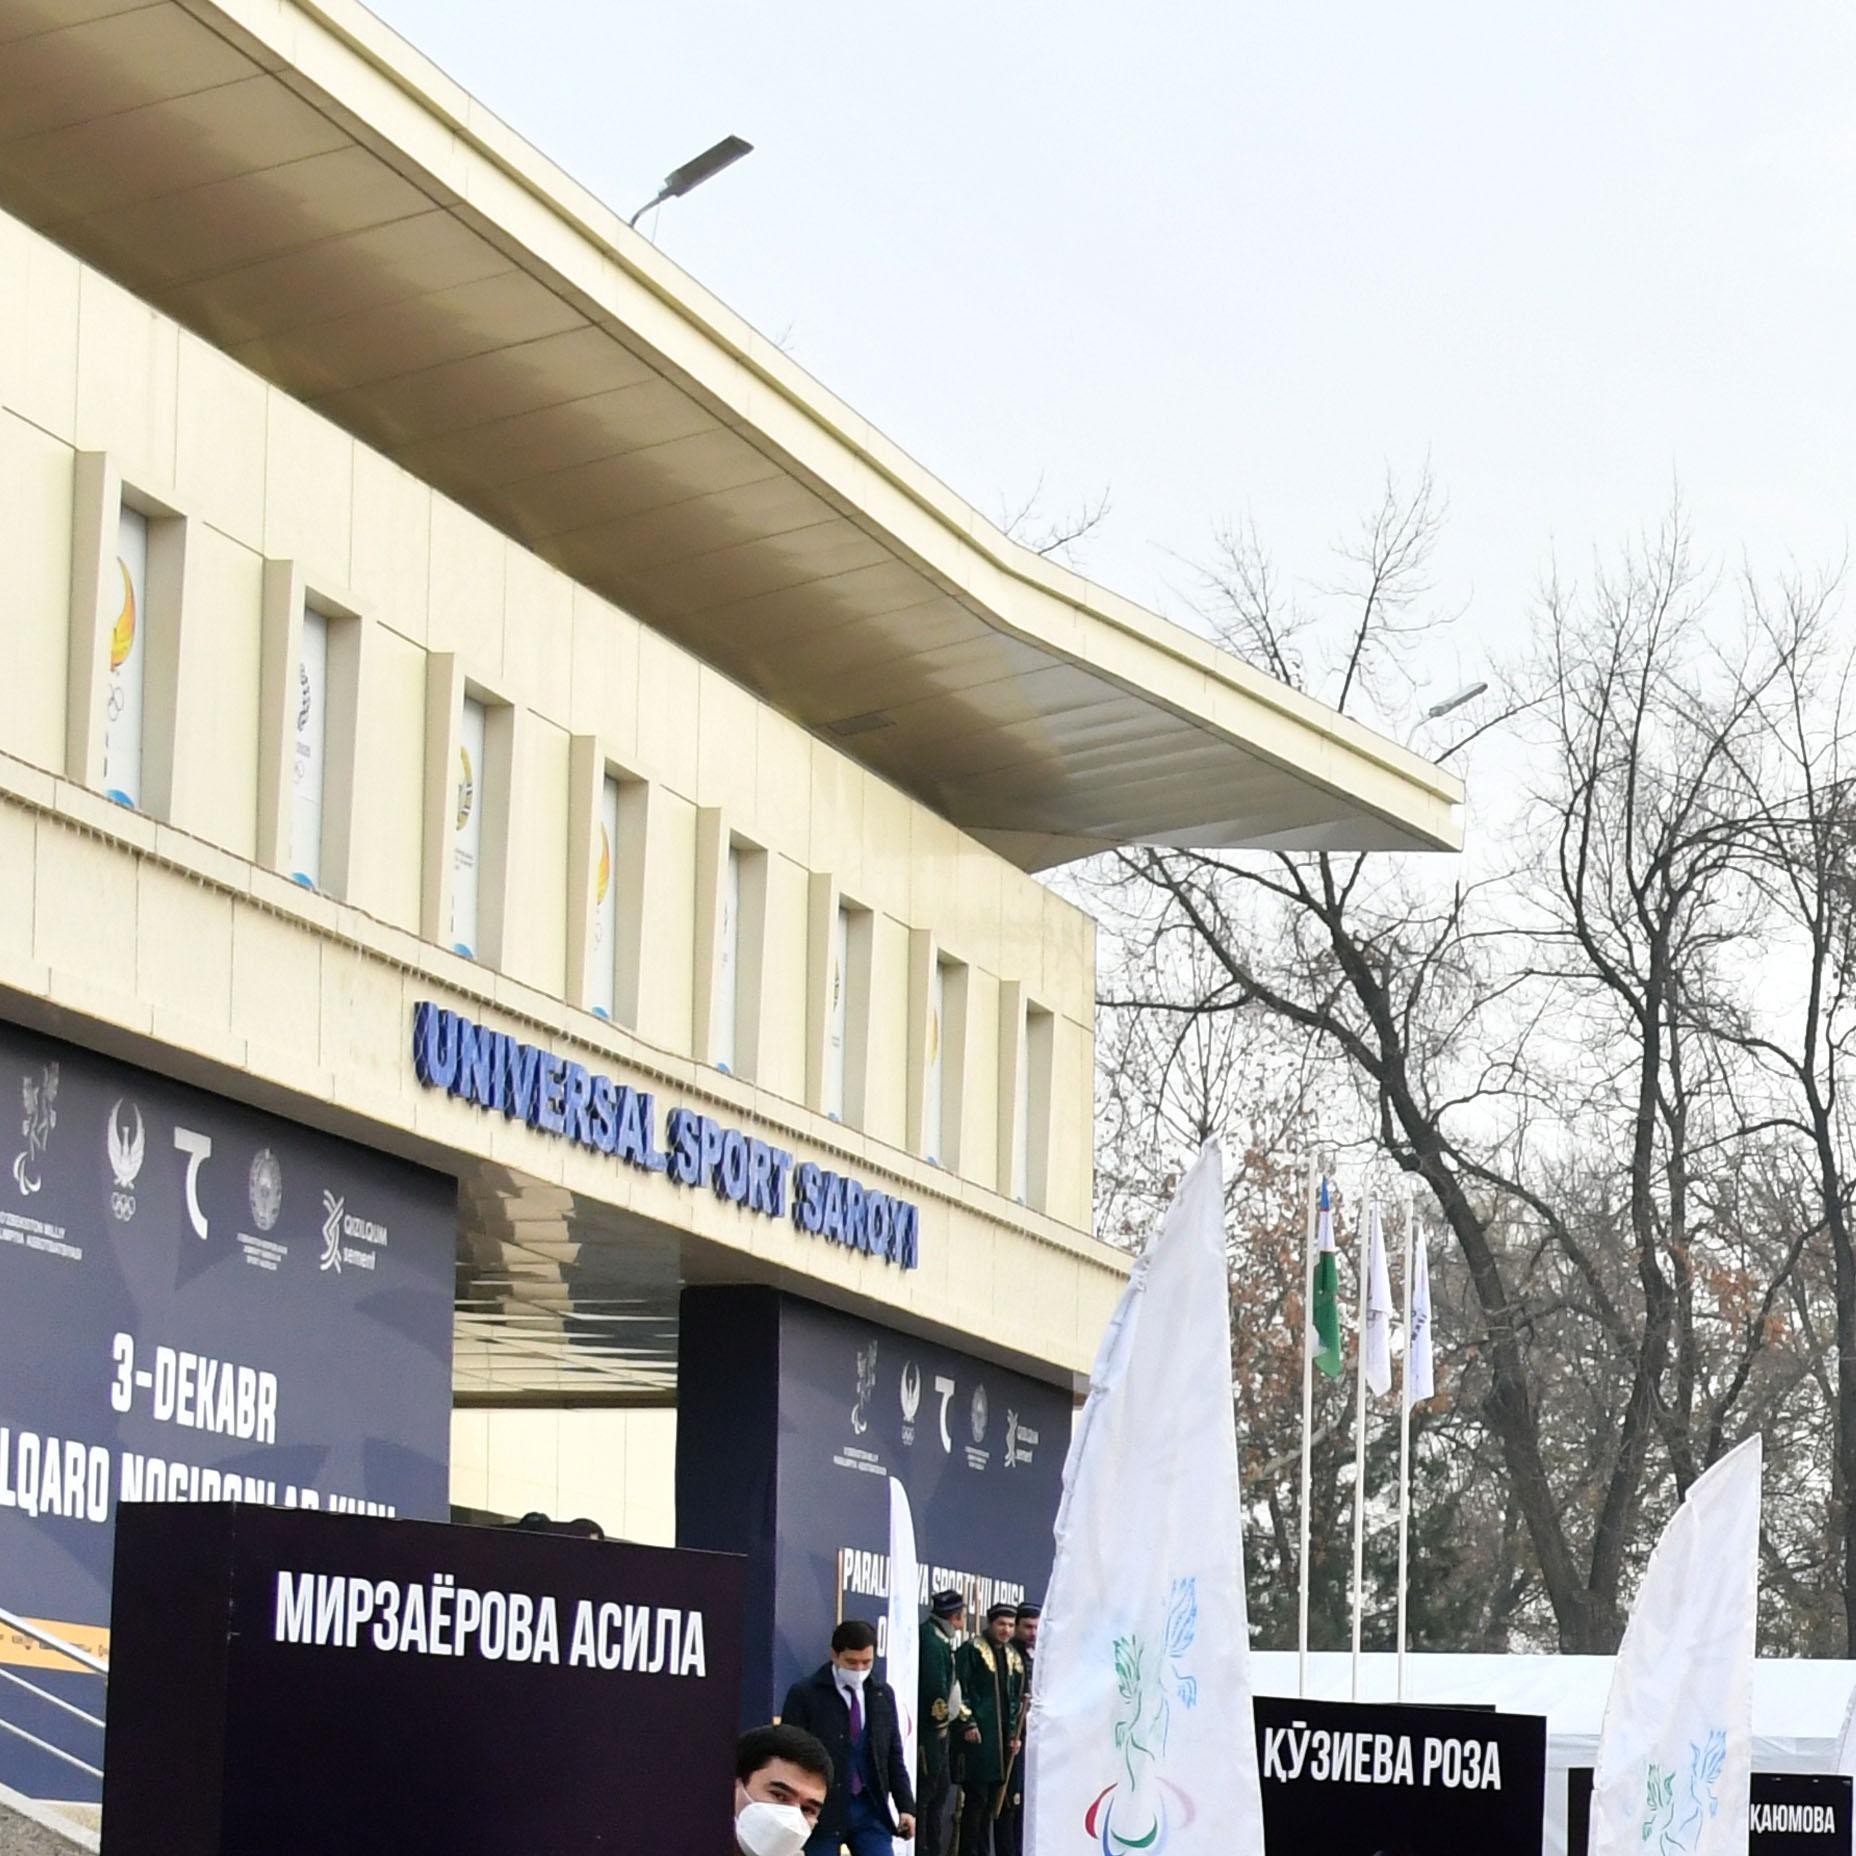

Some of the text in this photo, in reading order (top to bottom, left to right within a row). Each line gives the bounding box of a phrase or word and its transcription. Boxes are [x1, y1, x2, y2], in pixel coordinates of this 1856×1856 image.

[414, 1001, 919, 1271] UNIVERSAL SPORT SAROYI
[111, 1332, 279, 1444] 3-DEKABR
[275, 1571, 707, 1677] МИРЗАЁРОВА АСИЛА
[1422, 1736, 1502, 1791] РОЗА
